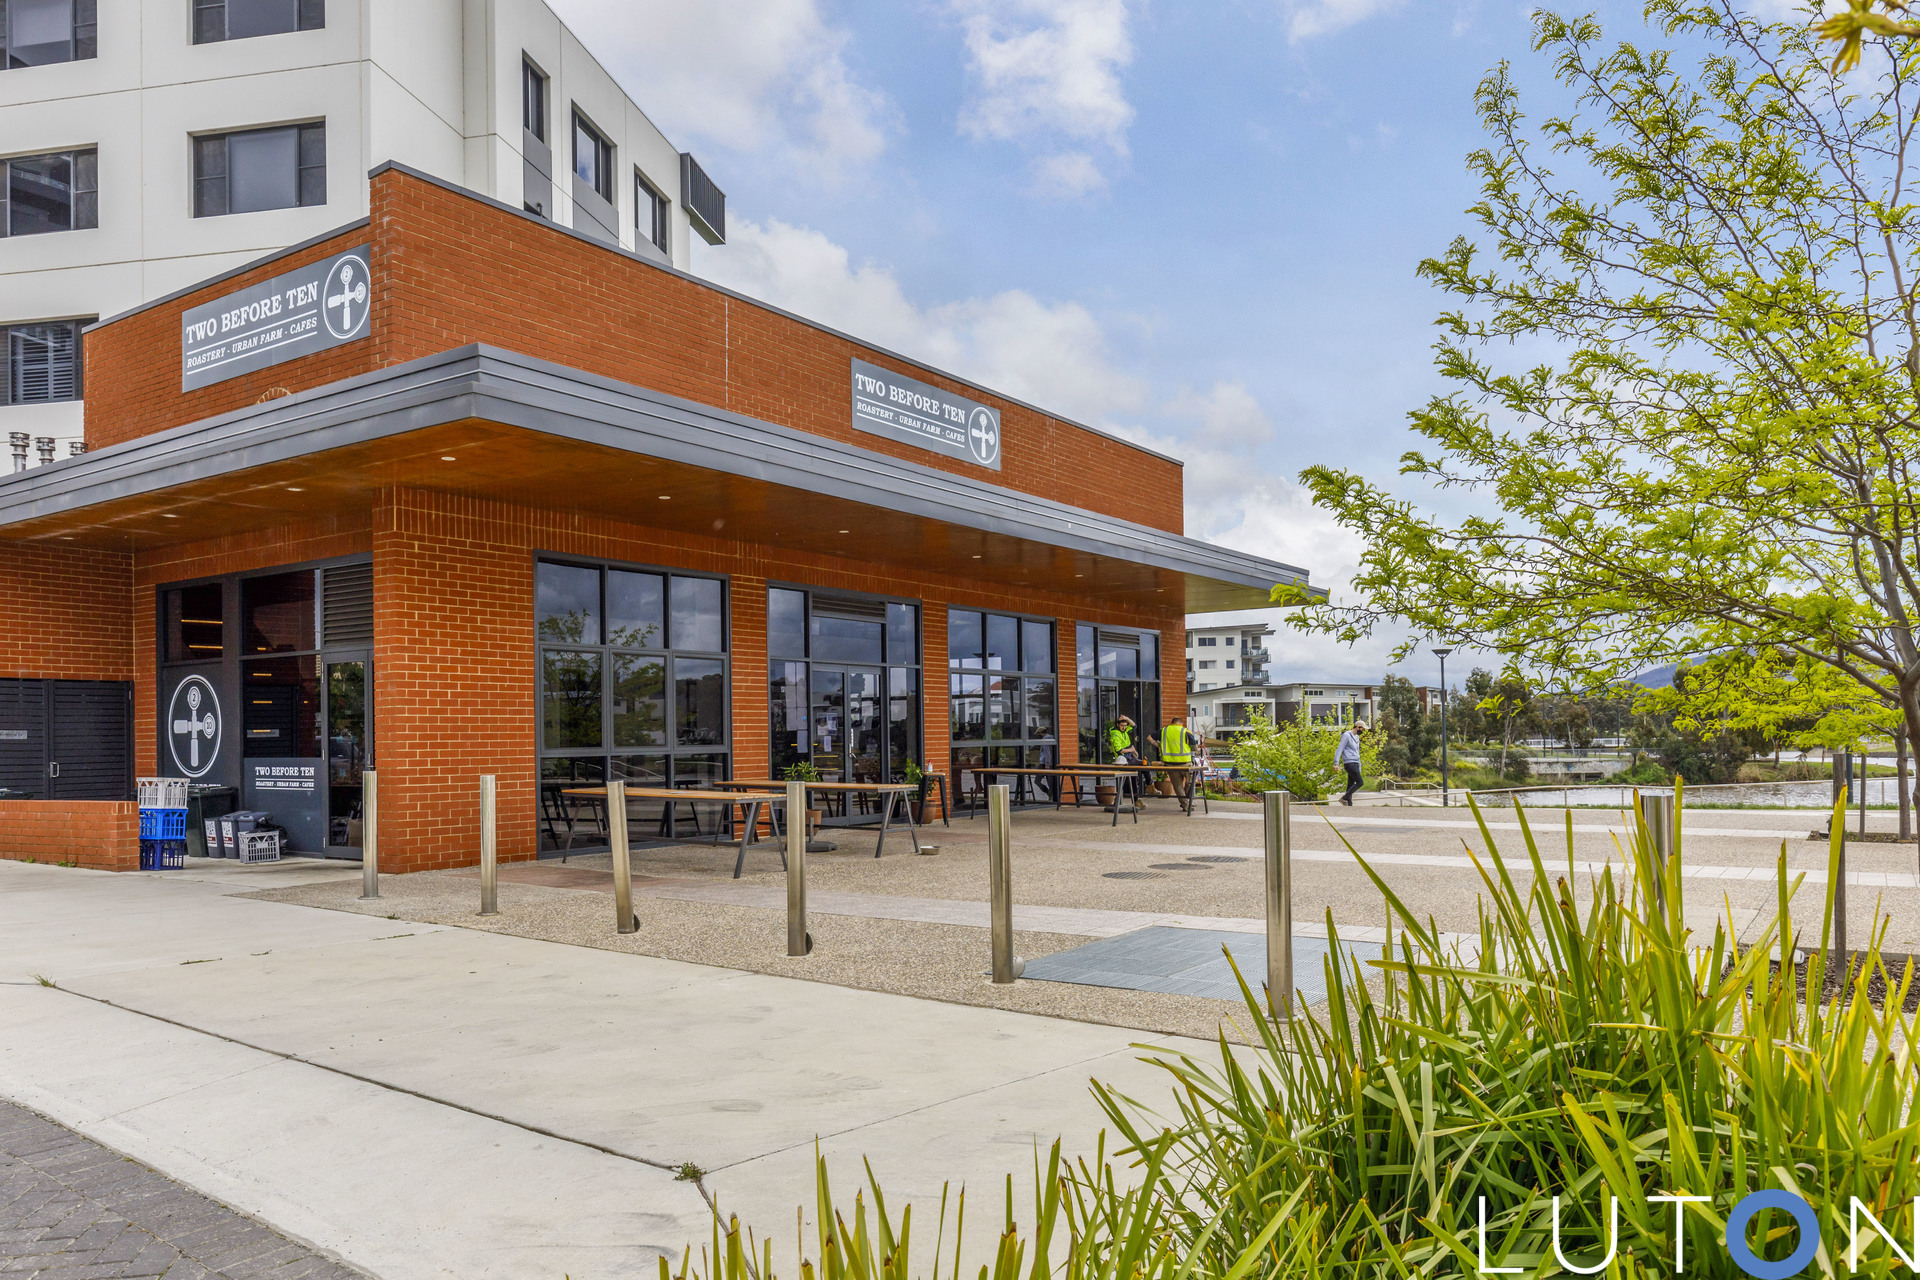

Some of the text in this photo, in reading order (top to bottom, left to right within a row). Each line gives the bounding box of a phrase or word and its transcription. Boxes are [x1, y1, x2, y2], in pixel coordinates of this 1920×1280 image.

[186, 281, 319, 344] TWO BEFORE TEN
[187, 348, 225, 369] ROASTERY
[232, 335, 258, 354] URBAN
[259, 328, 283, 345] FARM
[290, 317, 318, 335] CAFES
[855, 373, 966, 424] TWO BEFORE TEN
[857, 402, 894, 420] ROASTERY
[899, 415, 921, 429] URBAN
[922, 422, 941, 435] FARM
[945, 430, 966, 443] CAFES
[255, 766, 315, 776] TWO BEFORE TEN
